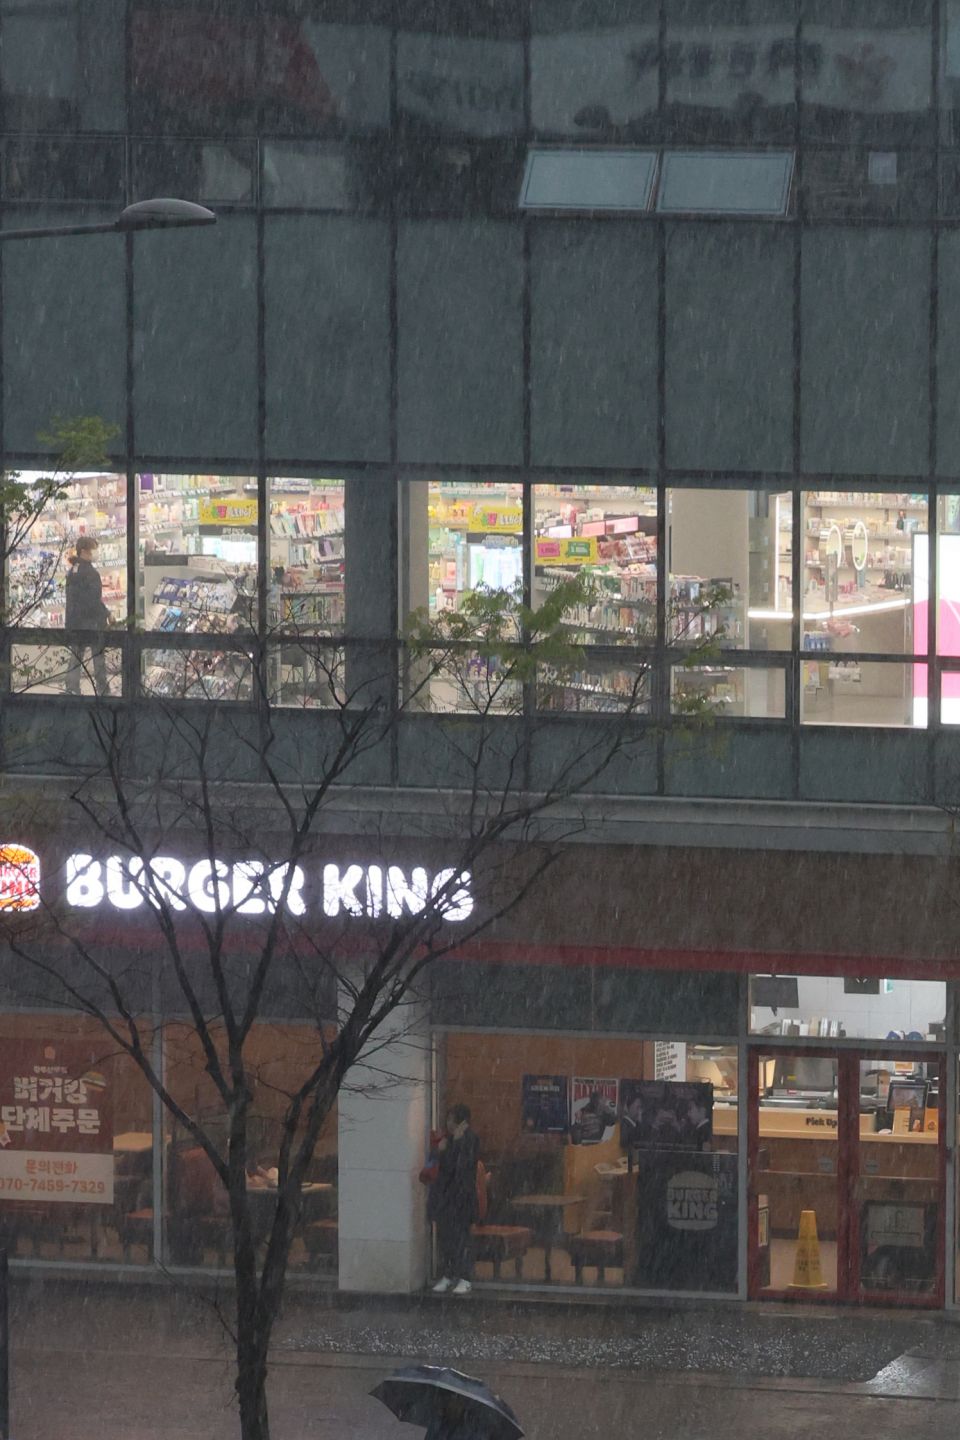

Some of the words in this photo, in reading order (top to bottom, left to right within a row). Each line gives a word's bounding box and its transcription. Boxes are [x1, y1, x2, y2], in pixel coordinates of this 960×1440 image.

[66, 853, 306, 916] BURGER
[323, 863, 474, 921] KING
[14, 1076, 87, 1104] 버거킹
[2, 1106, 101, 1134] 단체주문
[667, 1200, 719, 1219] KING
